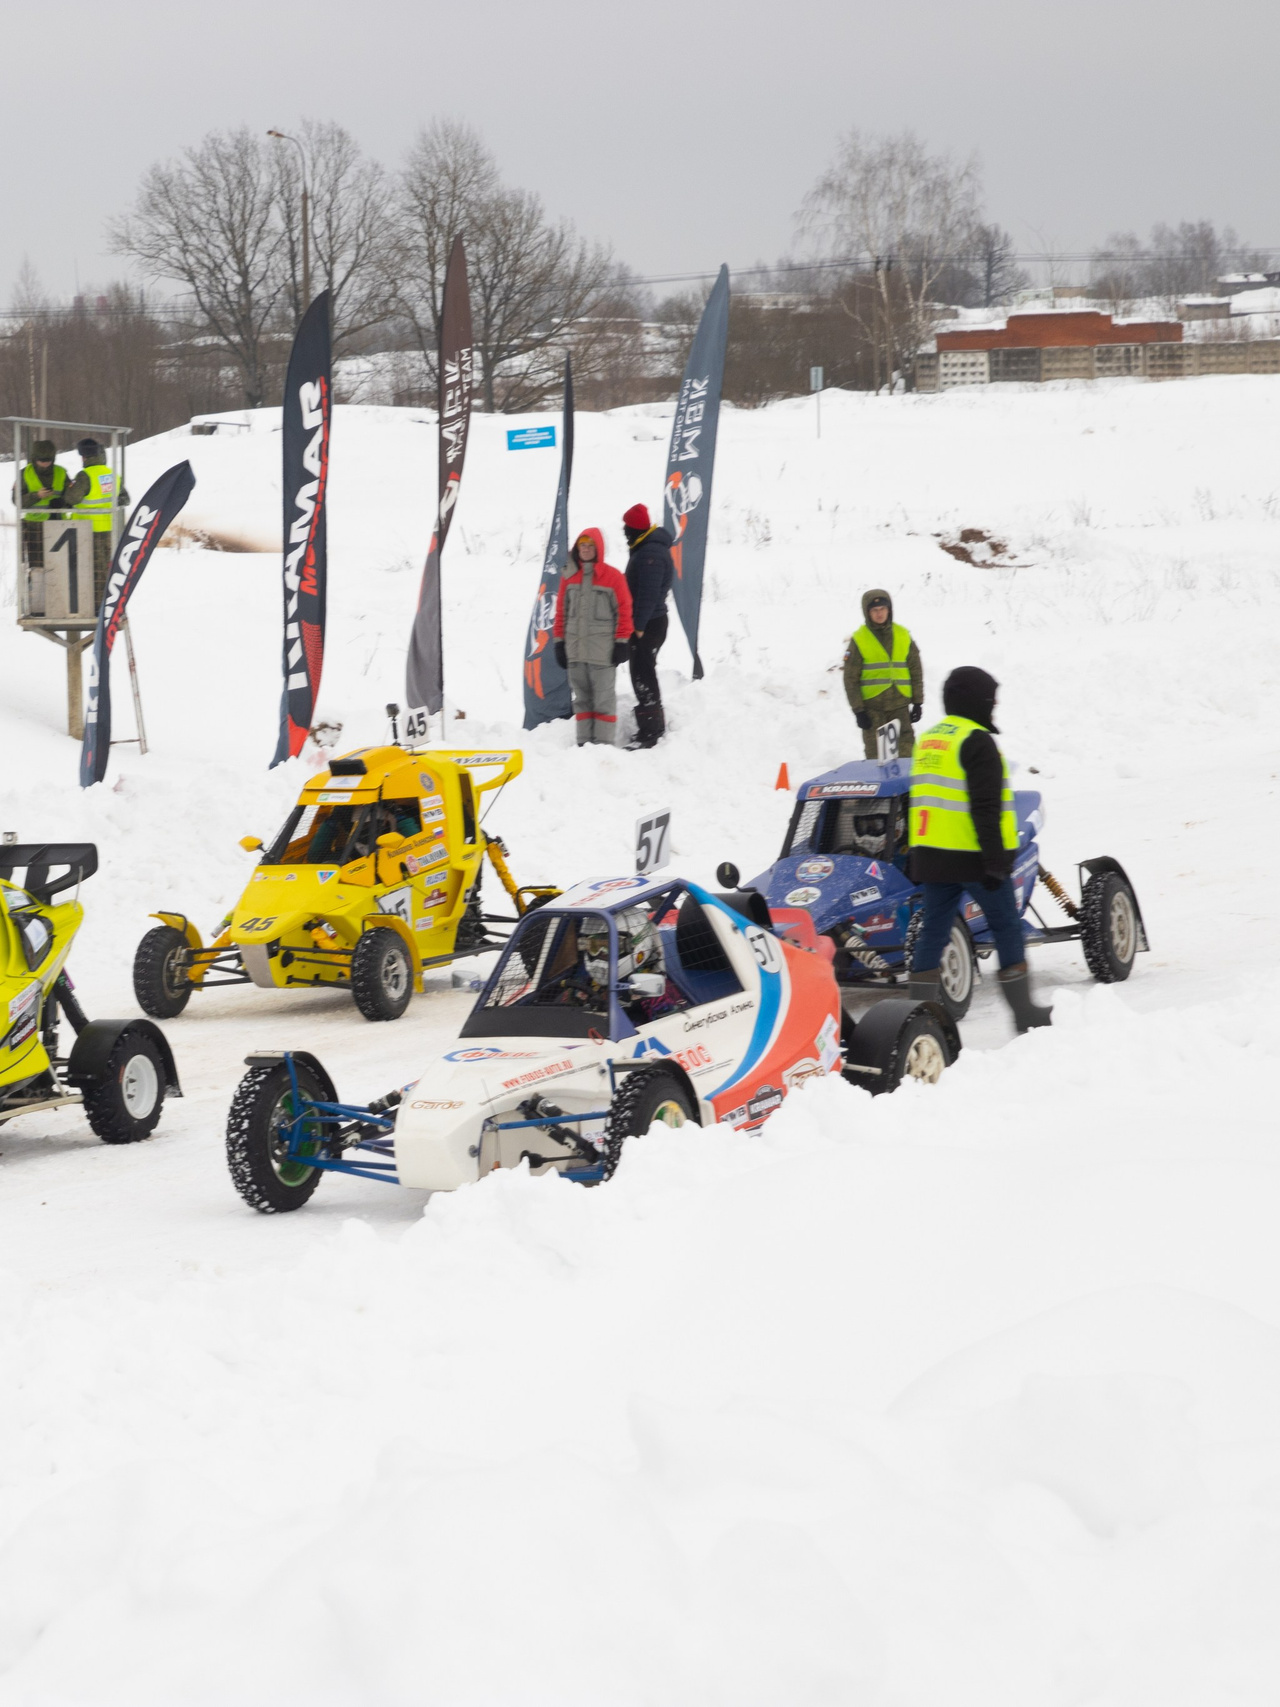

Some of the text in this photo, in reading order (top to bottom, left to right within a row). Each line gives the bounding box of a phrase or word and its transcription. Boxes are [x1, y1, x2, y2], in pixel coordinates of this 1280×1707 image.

[49, 527, 78, 615] 1
[407, 711, 427, 739] 45
[878, 722, 898, 760] 79
[822, 784, 879, 793] KRAMAR
[636, 812, 671, 872] 57
[238, 916, 280, 932] 45
[749, 932, 776, 966] 57
